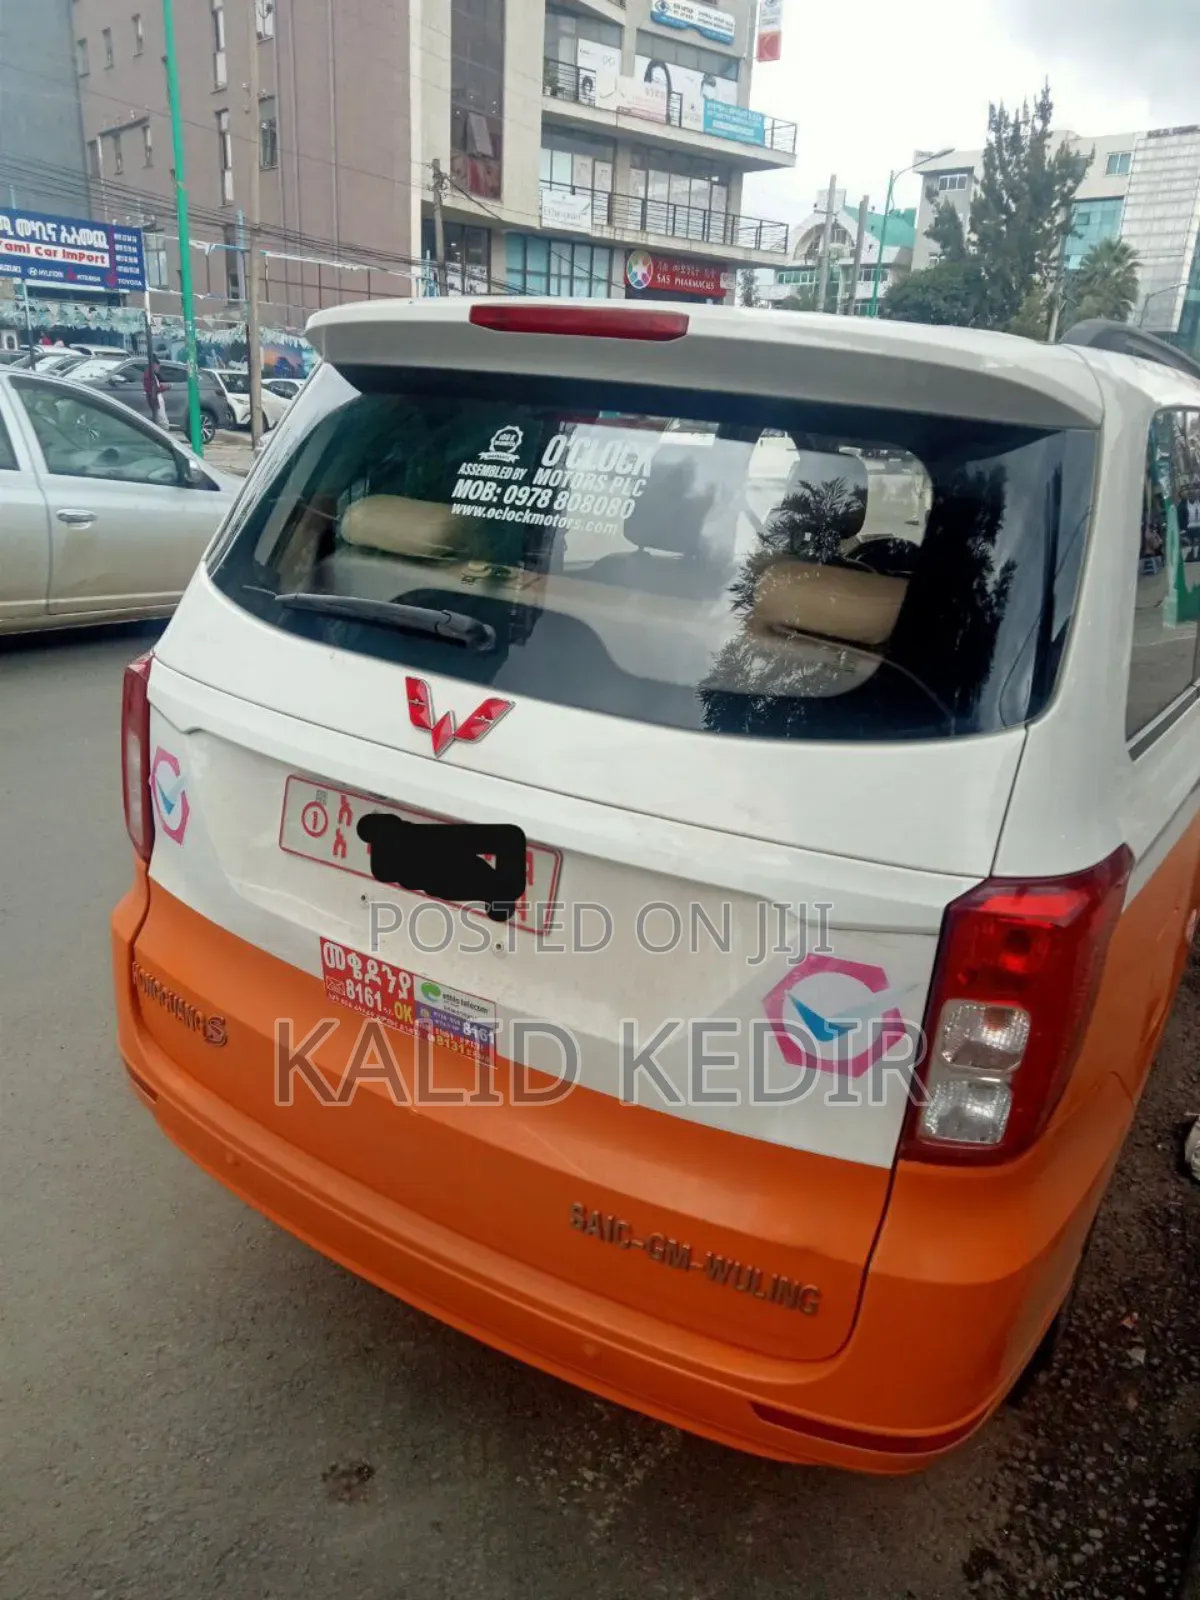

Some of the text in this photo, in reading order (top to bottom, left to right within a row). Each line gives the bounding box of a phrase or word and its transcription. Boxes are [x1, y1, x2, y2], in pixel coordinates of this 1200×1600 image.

[0, 240, 30, 254] ami
[34, 246, 58, 258] Car
[117, 278, 143, 287] TOYOTA
[541, 434, 654, 477] O'CLOCK
[457, 462, 529, 481] ASSEMBLED BY
[532, 467, 648, 497] MOTORS PLC
[451, 478, 636, 519] MOB: 0978 808080
[451, 503, 618, 536] www.oclockmotors.com
[346, 979, 382, 1012] 8161
[460, 999, 488, 1014] telecom
[394, 1000, 413, 1024] OK
[205, 1015, 228, 1046] S
[569, 1201, 822, 1316] SAIC-GM-WULING
